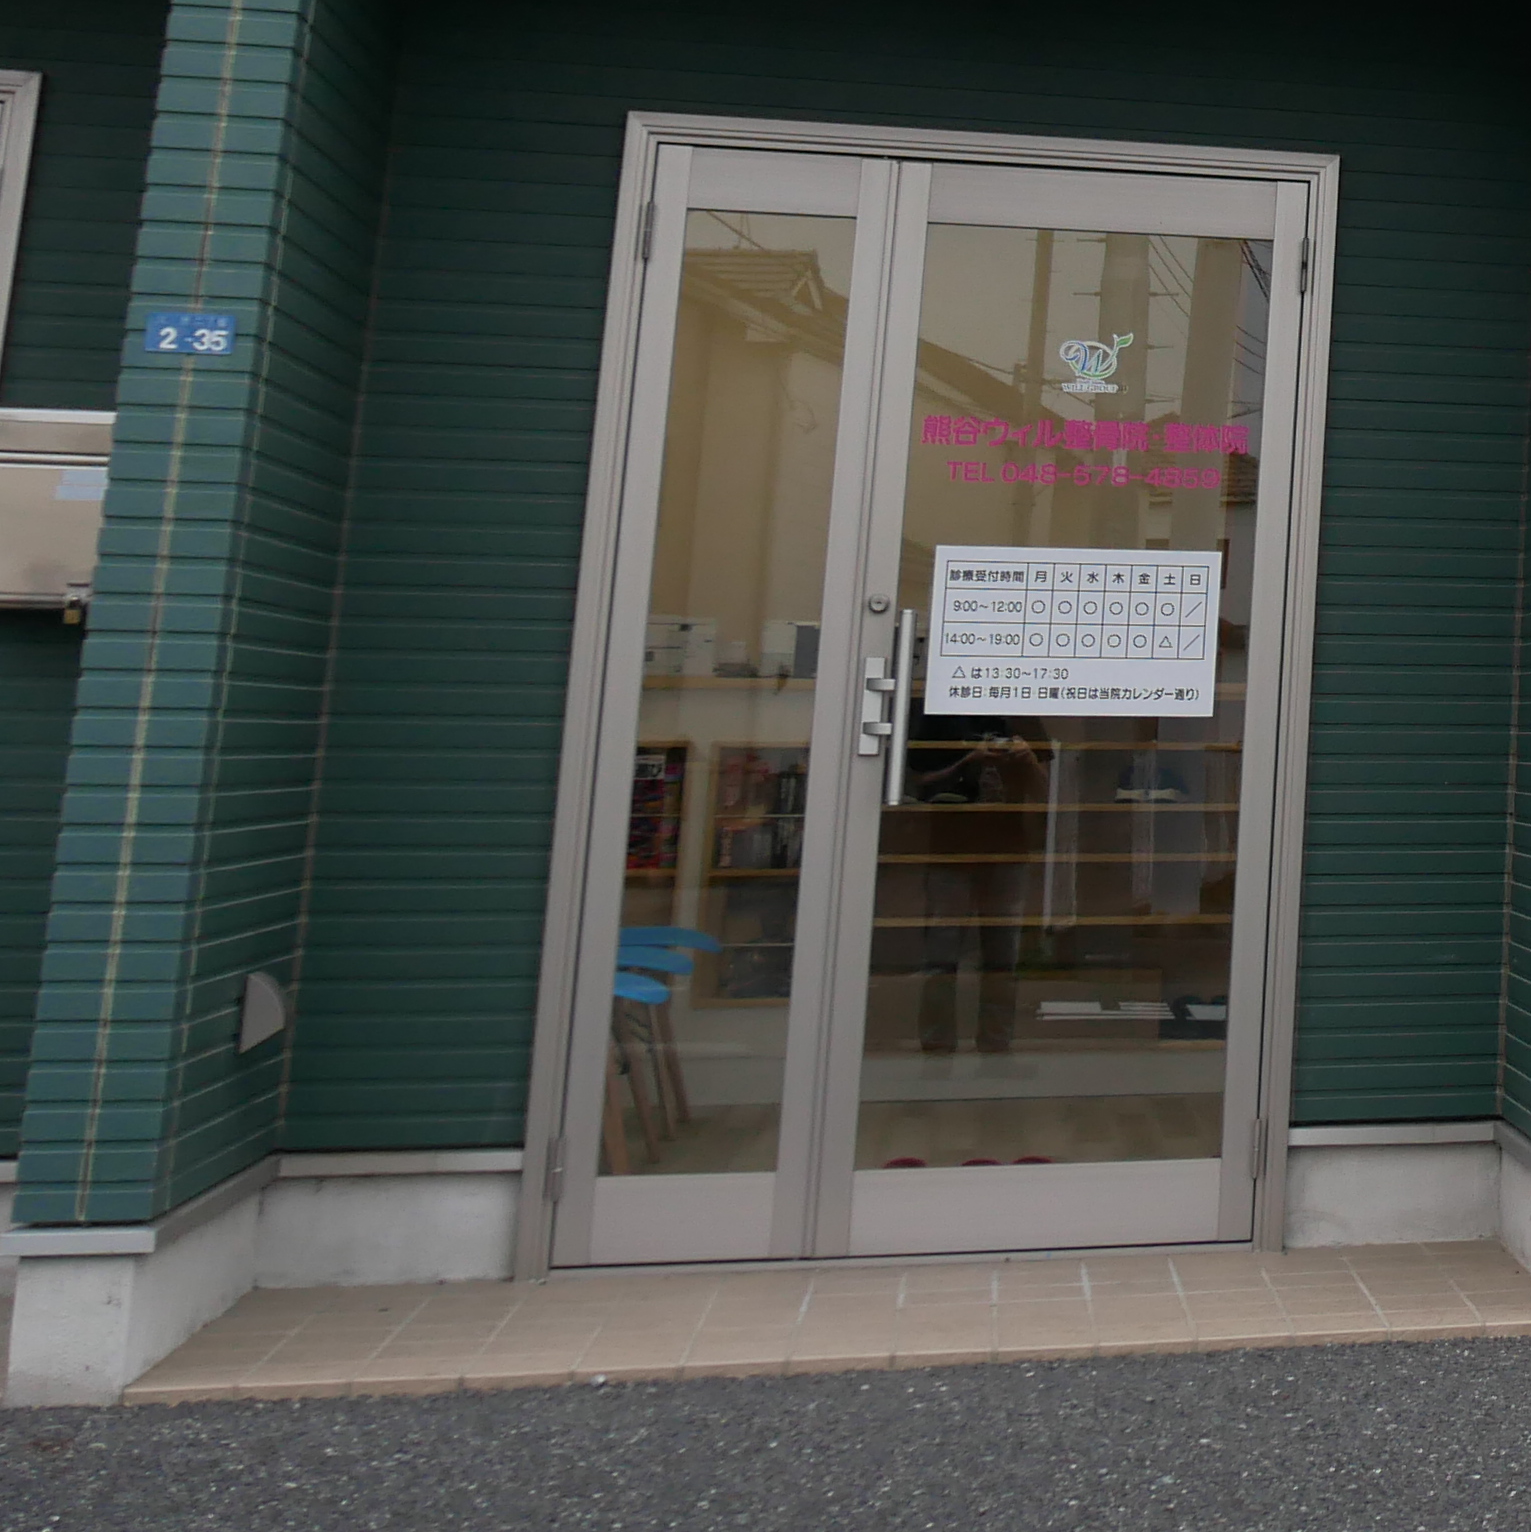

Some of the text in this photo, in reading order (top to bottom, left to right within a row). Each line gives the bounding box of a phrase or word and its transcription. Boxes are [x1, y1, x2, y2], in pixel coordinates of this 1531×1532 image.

[947, 461, 1221, 490] TEL 048-578-4859
[1034, 570, 1047, 583] 月
[1060, 571, 1073, 583] 火
[1086, 571, 1099, 584] 水
[1112, 572, 1125, 584] 木
[1138, 573, 1151, 585] 金
[1163, 573, 1176, 586] 土
[1189, 574, 1202, 586] 日
